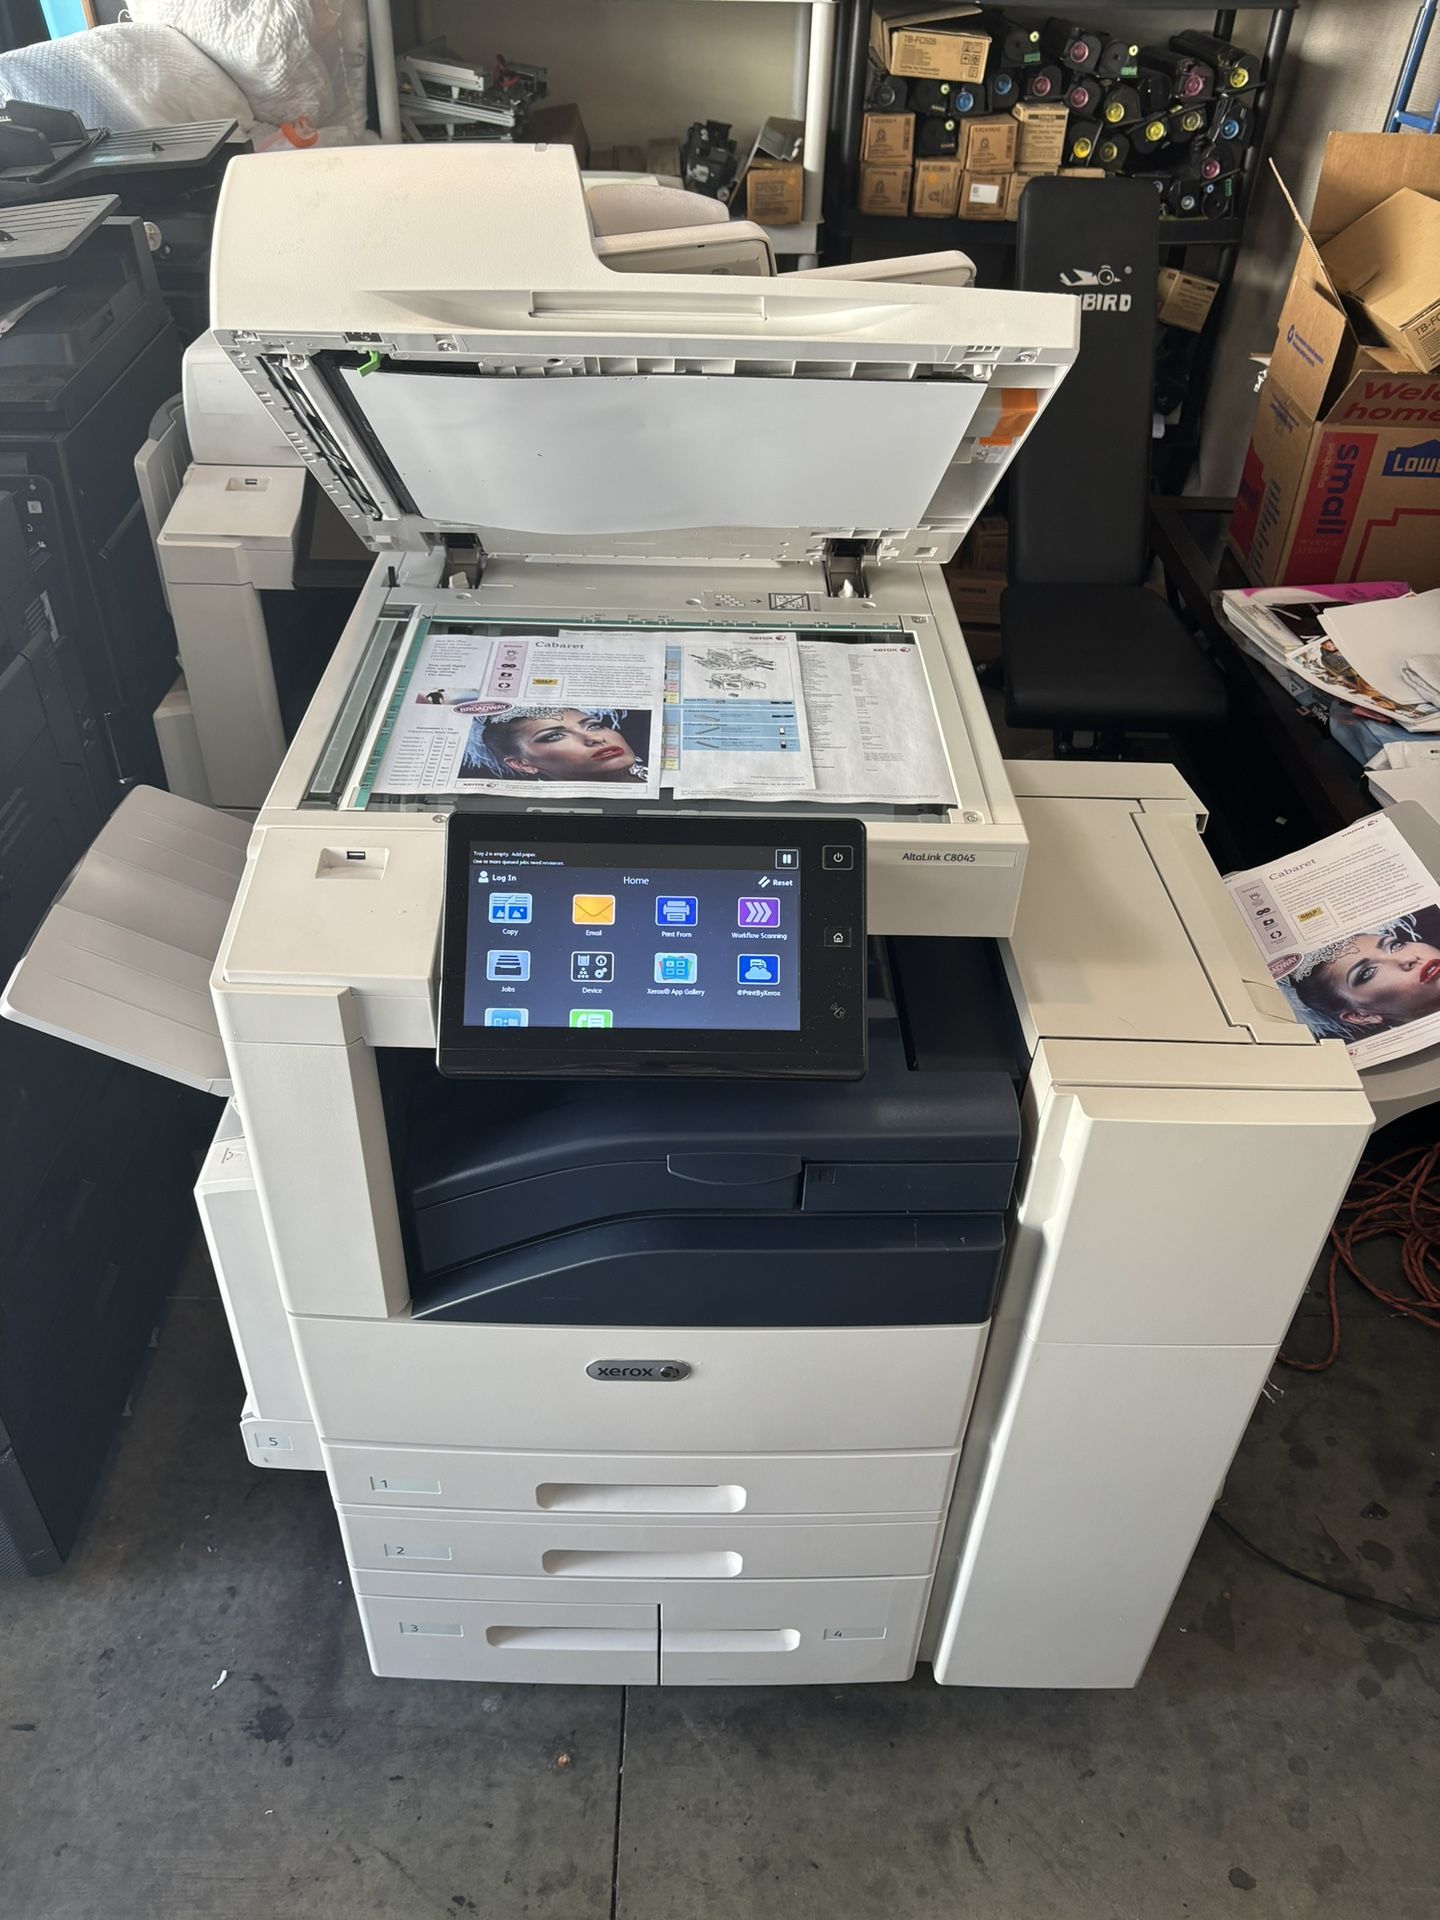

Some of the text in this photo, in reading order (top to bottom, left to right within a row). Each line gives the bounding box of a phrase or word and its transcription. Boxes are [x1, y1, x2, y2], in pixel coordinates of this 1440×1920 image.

[1080, 293, 1132, 312] BIRD
[1316, 443, 1360, 535] small
[535, 641, 585, 649] Cabaret
[460, 704, 508, 713] BROADWAY
[902, 852, 976, 863] AltaLink C8045
[1268, 859, 1318, 881] Cabaret
[492, 874, 506, 882] Log
[623, 876, 650, 885] Home
[772, 879, 793, 887] Reset
[502, 928, 518, 936] Copy
[760, 932, 787, 941] Scanning
[671, 988, 683, 997] App
[684, 988, 705, 997] Gallery
[737, 989, 781, 997] @PrintByXerox
[598, 1367, 653, 1377] xerox
[269, 1437, 278, 1446] 5
[381, 1479, 388, 1488] 1
[396, 1546, 405, 1555] 2
[410, 1624, 419, 1633] 3
[834, 1630, 842, 1638] 4
